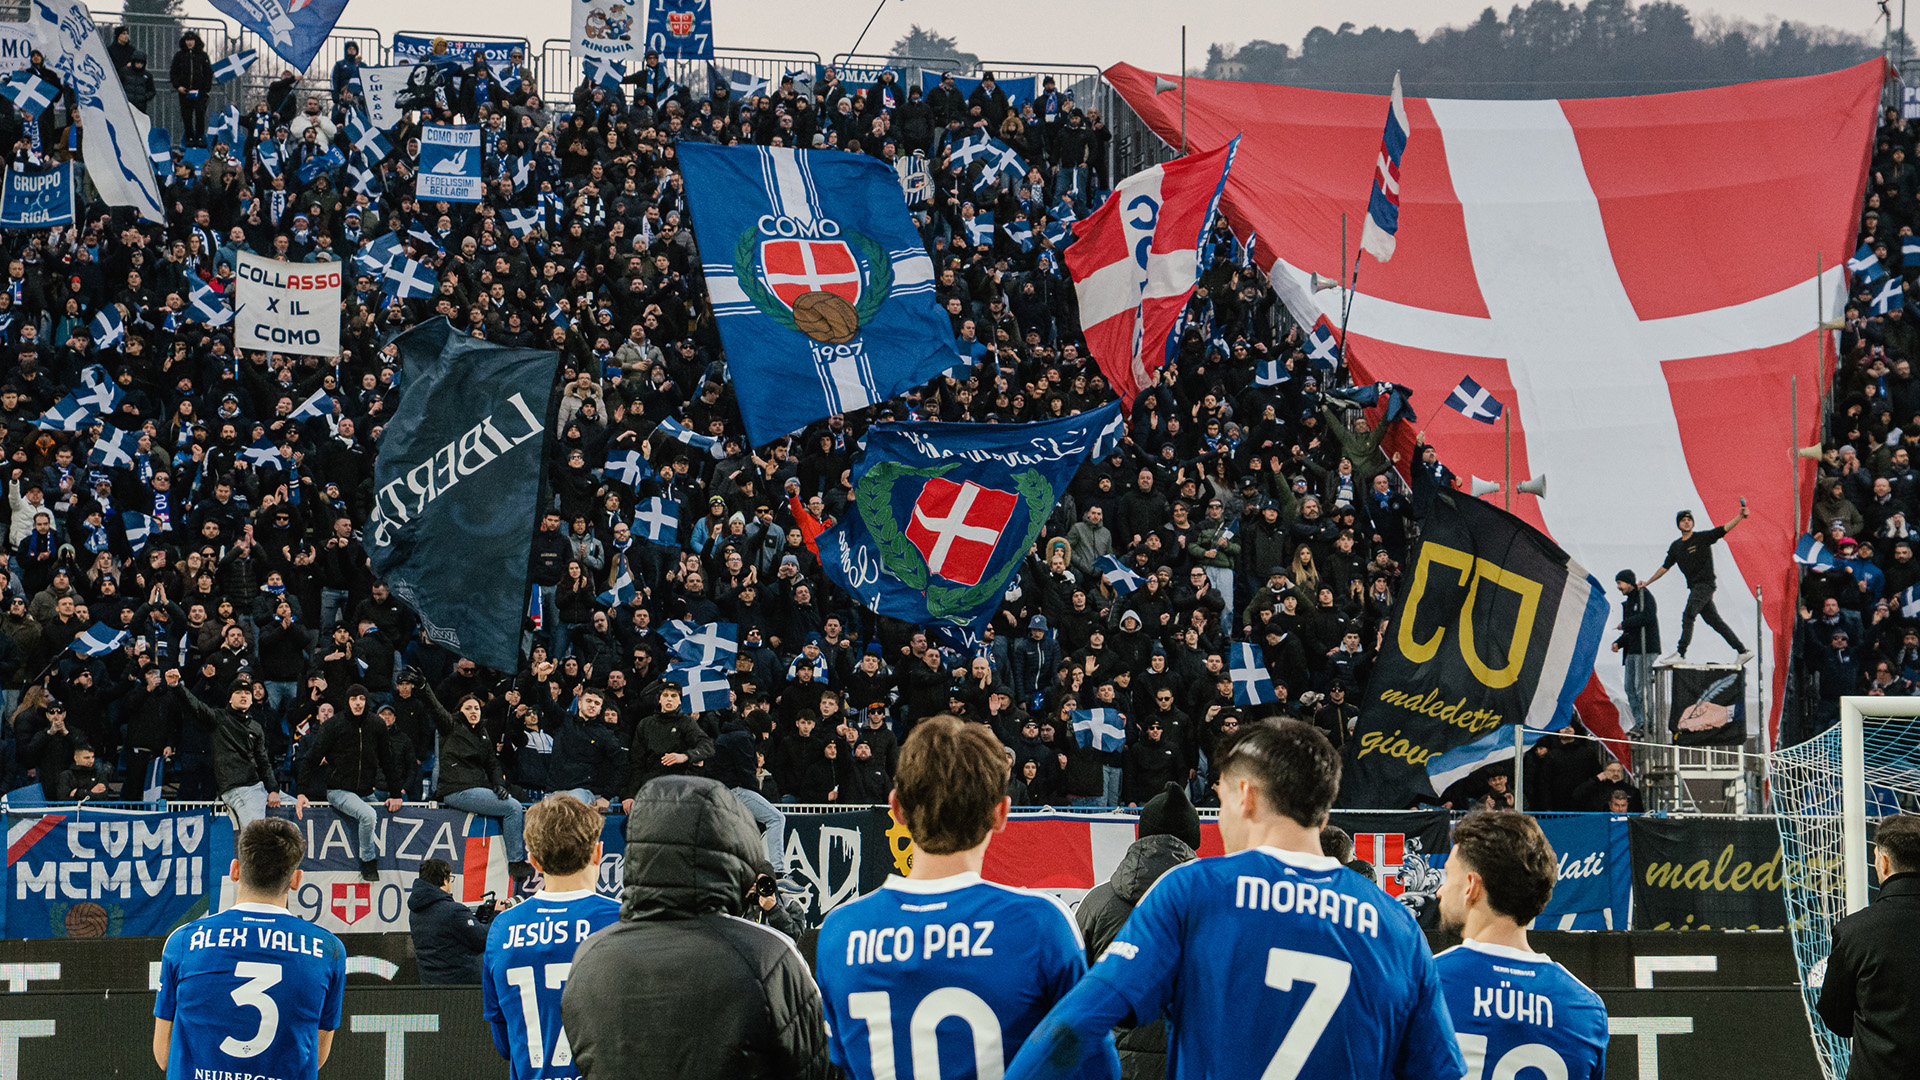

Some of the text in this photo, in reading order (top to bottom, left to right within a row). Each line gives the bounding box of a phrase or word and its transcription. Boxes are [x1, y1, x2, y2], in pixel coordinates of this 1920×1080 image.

[581, 38, 634, 53] RINGHIA
[427, 128, 473, 144] COMO 1907
[14, 171, 61, 191] GRUPPO
[425, 176, 475, 188] FEDELISSIMI
[430, 186, 469, 198] BELLAGIO
[21, 208, 50, 224] RIGA
[758, 214, 840, 238] COMO
[238, 262, 341, 290] COLLASSO
[266, 296, 310, 316] X IL
[254, 323, 321, 345] COMO
[811, 342, 863, 363] 1907
[67, 815, 204, 858] COMO
[16, 856, 203, 899] MCMVII
[1235, 875, 1379, 938] MORATA
[190, 925, 324, 958] ÁLEX VALLE
[503, 916, 569, 949] JESÚS
[846, 920, 994, 965] NICO PAZ
[219, 961, 282, 1059] 3
[1264, 947, 1352, 1080] 7
[1473, 980, 1553, 1029] KÜHN
[848, 986, 1005, 1080] 10
